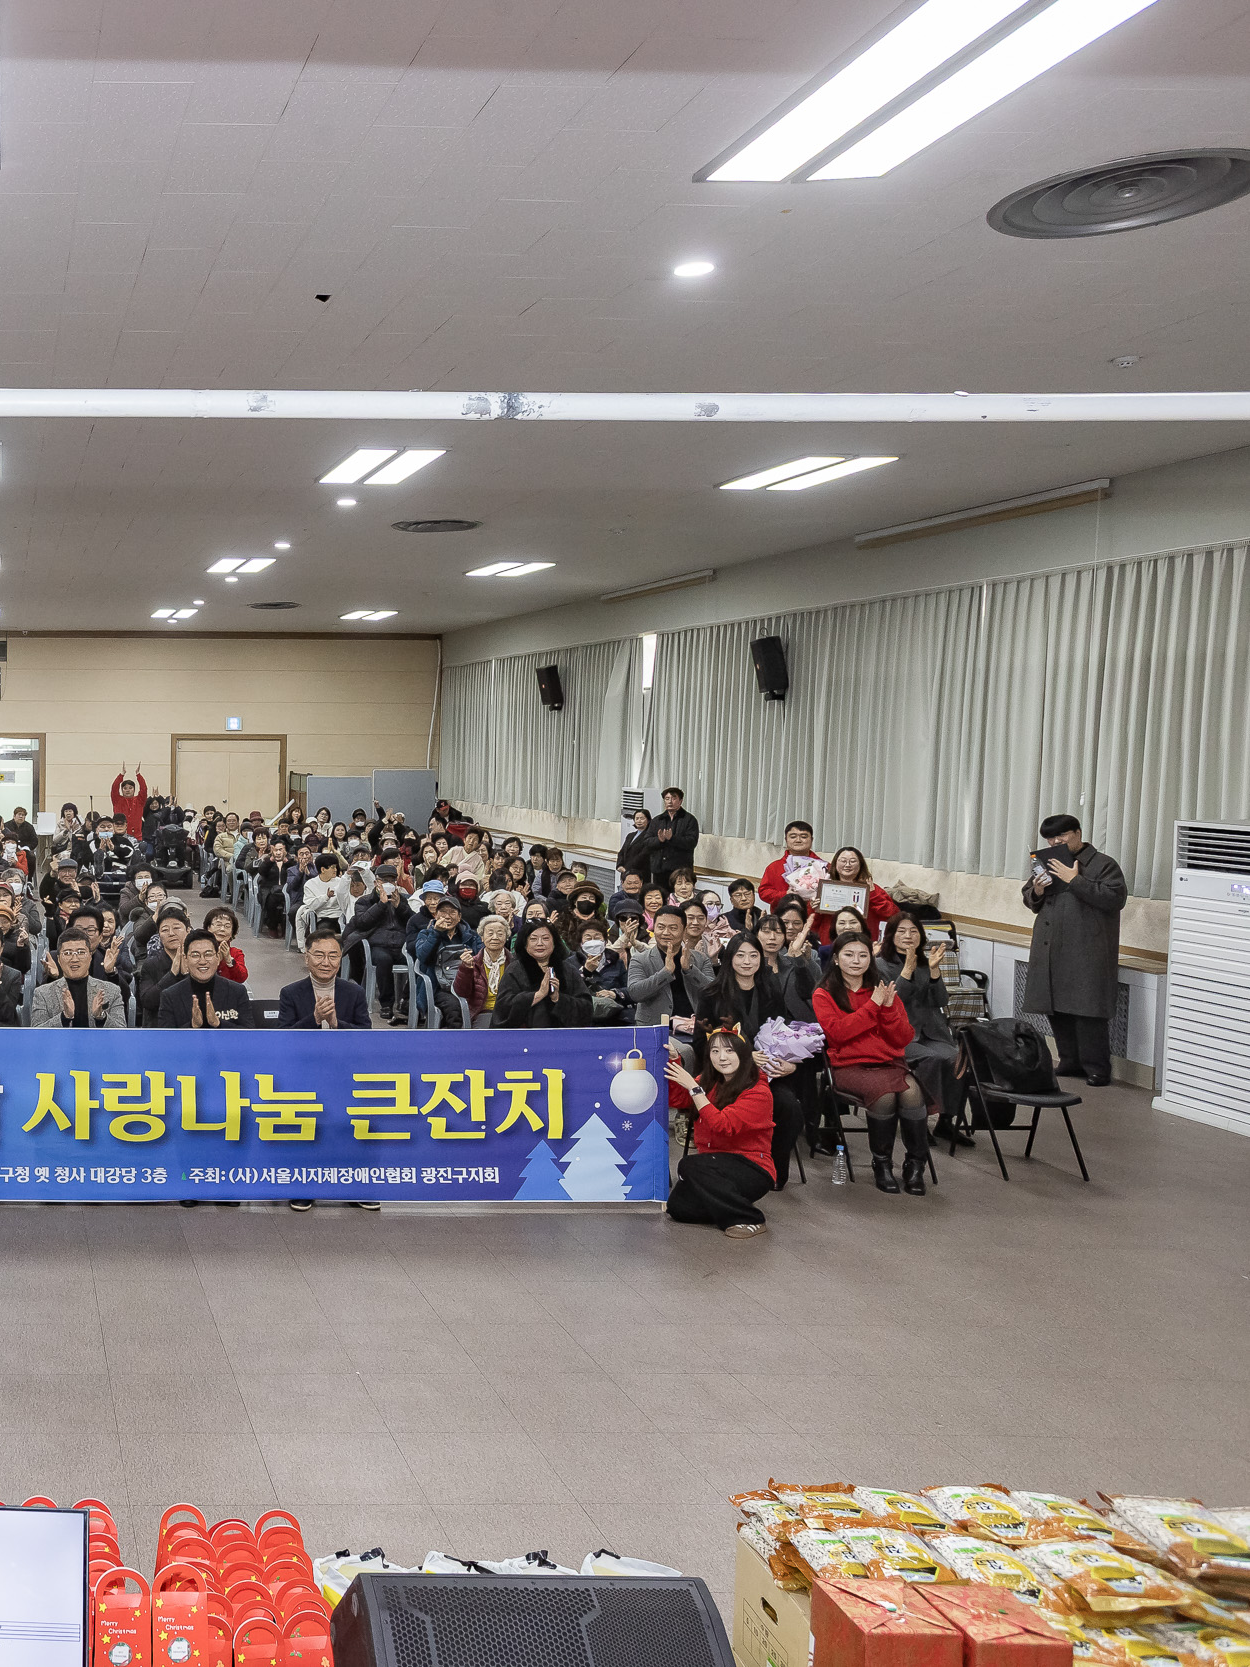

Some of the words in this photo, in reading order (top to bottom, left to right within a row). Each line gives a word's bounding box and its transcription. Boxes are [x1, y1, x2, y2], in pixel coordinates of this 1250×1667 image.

[22, 1070, 324, 1142] 사랑나눔
[347, 1069, 564, 1140] 큰잔치
[34, 1166, 50, 1183] 옛
[53, 1166, 87, 1184] 청사
[90, 1166, 138, 1184] 대강당
[141, 1167, 168, 1185] 3층
[421, 1166, 500, 1185] 광진구지회
